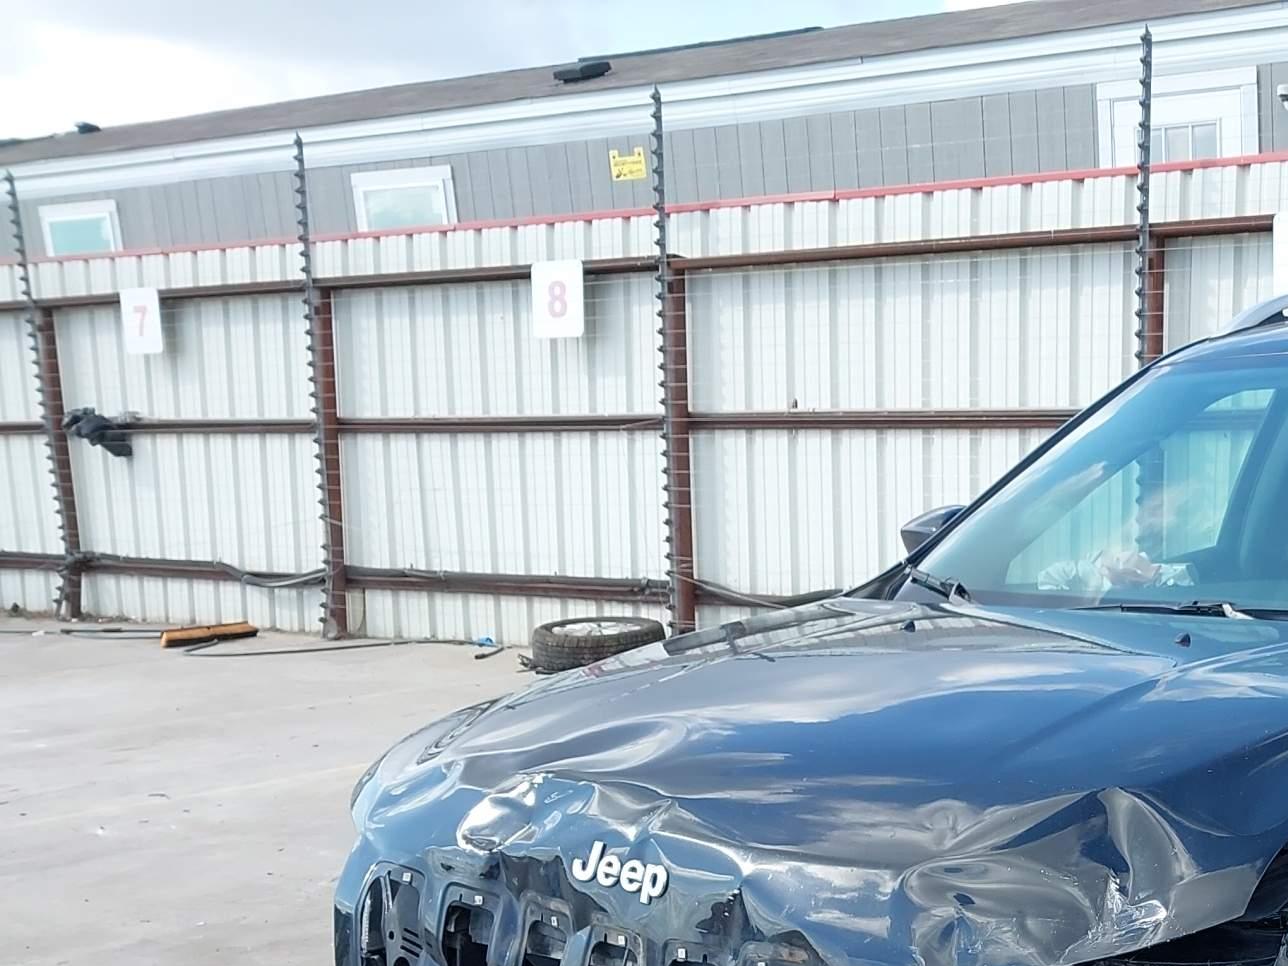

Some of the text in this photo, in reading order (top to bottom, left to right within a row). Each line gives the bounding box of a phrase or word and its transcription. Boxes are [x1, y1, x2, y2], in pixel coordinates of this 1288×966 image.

[548, 280, 568, 318] 8
[133, 305, 147, 337] 7
[571, 840, 669, 905] Jeep
